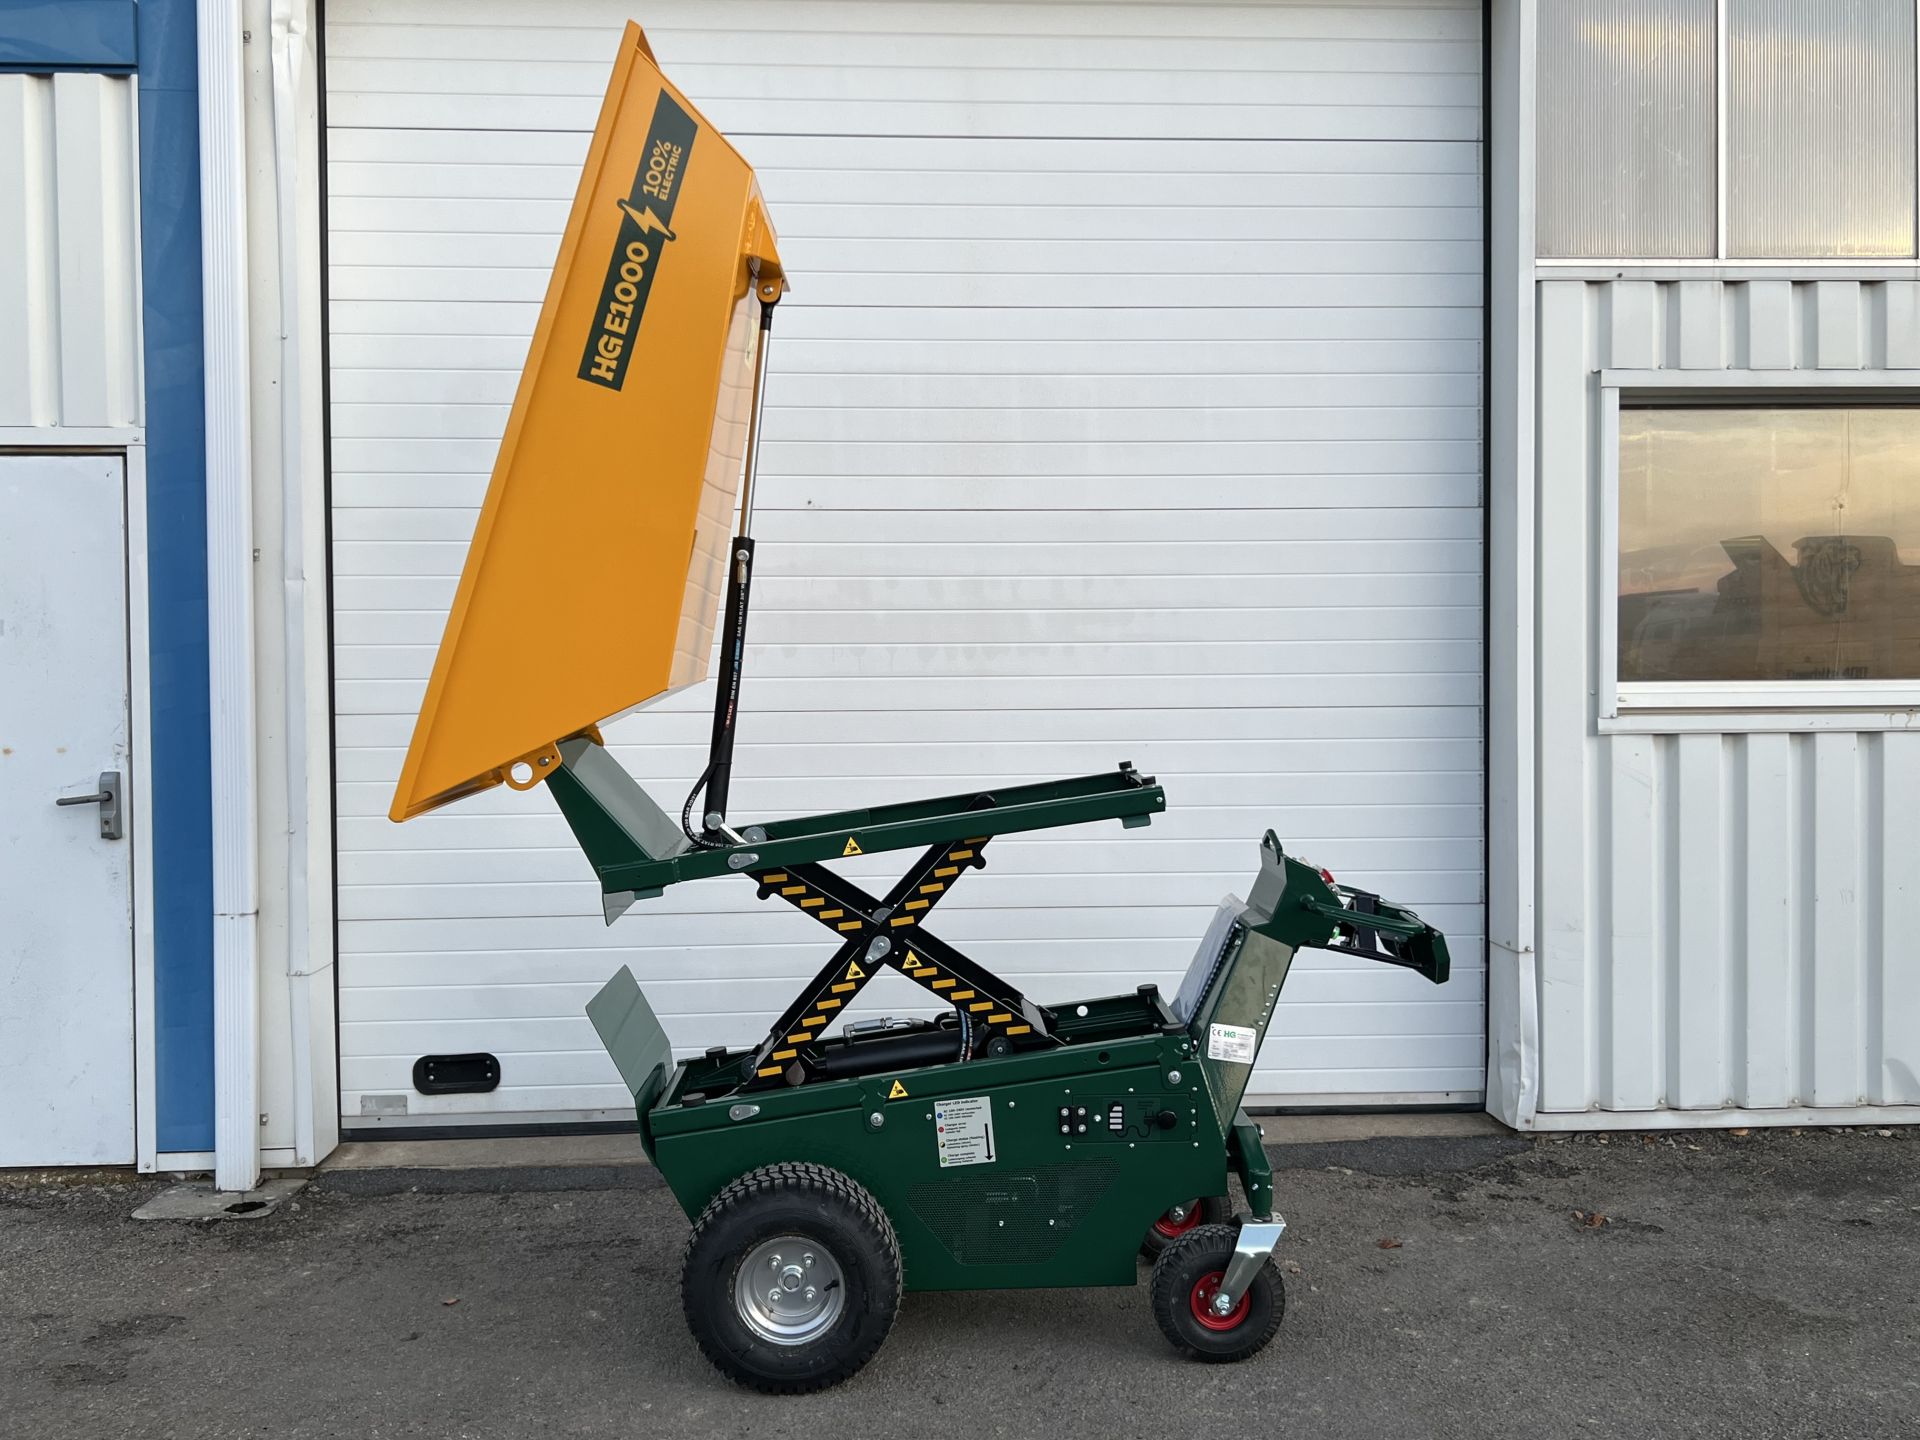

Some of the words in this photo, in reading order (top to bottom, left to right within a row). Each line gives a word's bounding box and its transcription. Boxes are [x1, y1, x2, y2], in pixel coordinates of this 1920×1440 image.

[643, 140, 672, 197] 100%
[659, 144, 682, 201] ELECTRIC
[604, 242, 650, 336] E1000
[1223, 1030, 1237, 1038] HG
